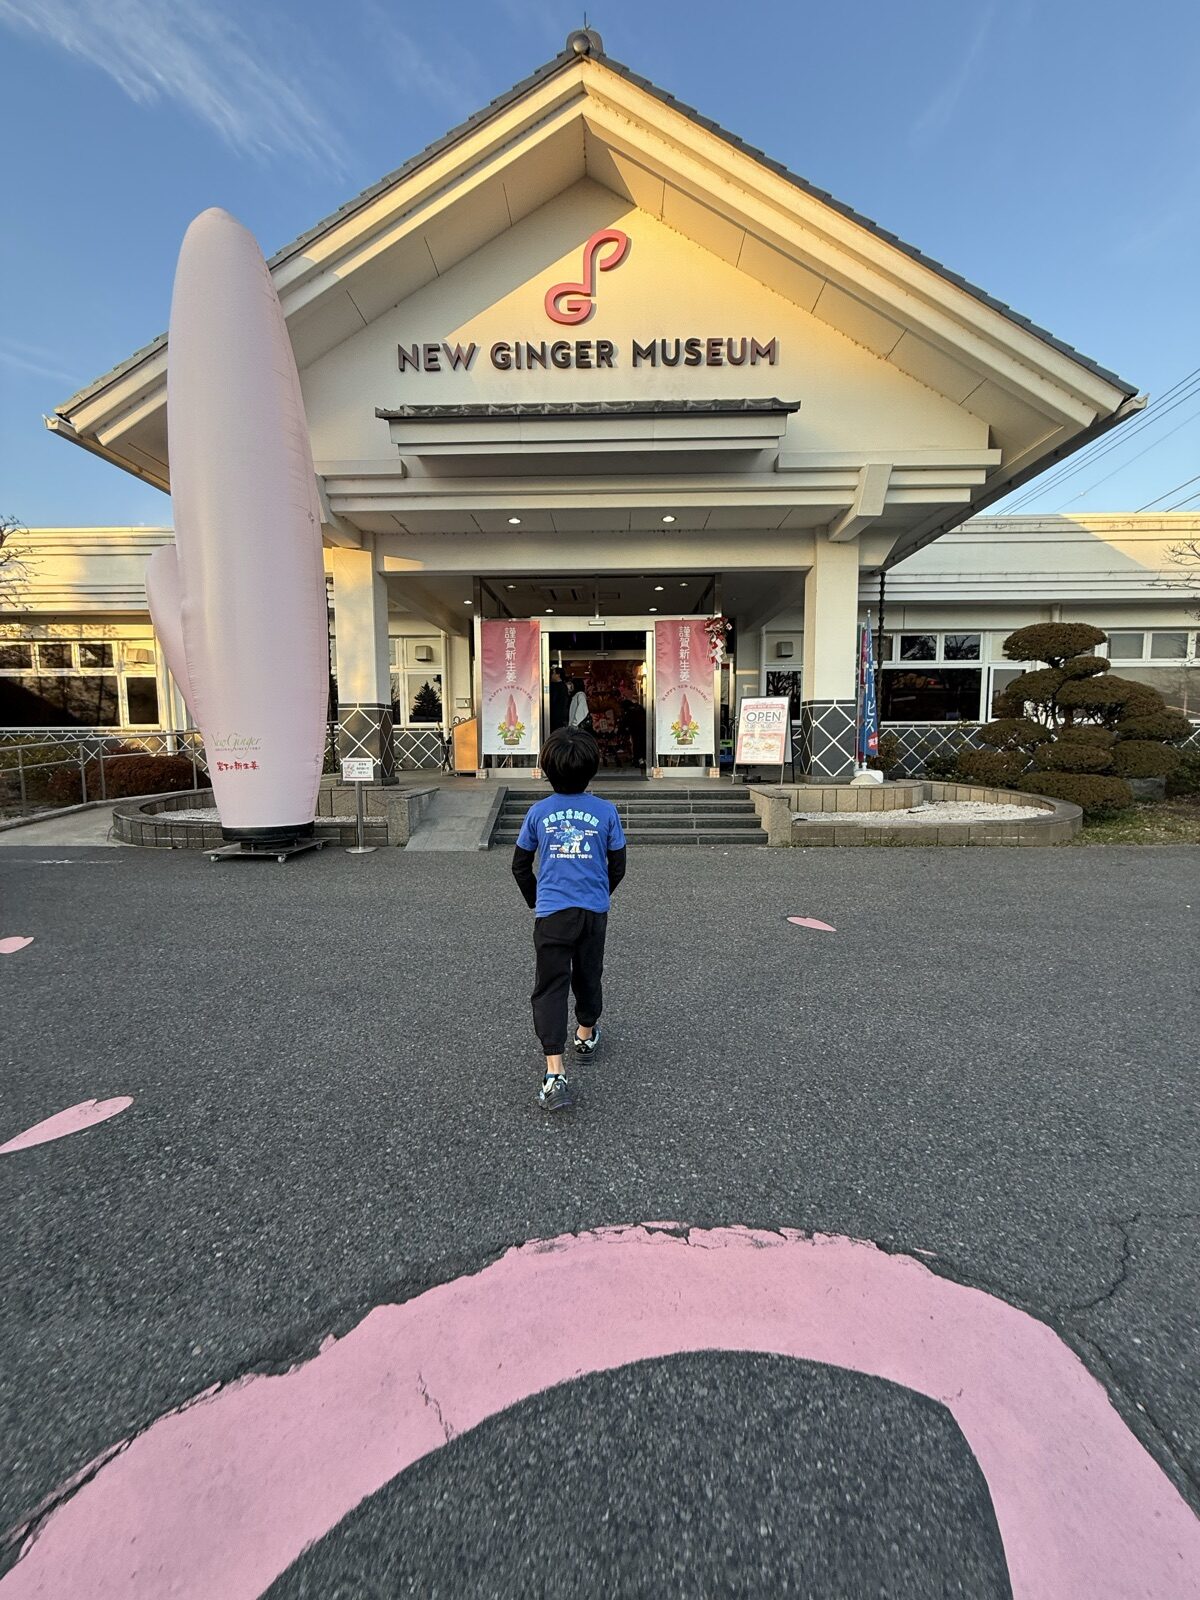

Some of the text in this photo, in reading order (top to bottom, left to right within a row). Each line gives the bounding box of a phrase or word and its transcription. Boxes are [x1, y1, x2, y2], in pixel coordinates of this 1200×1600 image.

[397, 337, 777, 372] NEW GINGER MUSEUM
[504, 627, 517, 683] 謹賀新生姜
[679, 626, 691, 683] 謹賀新生姜
[662, 687, 677, 702] HAPPY
[746, 711, 781, 722] OPEN
[543, 809, 599, 827] POKÉMON
